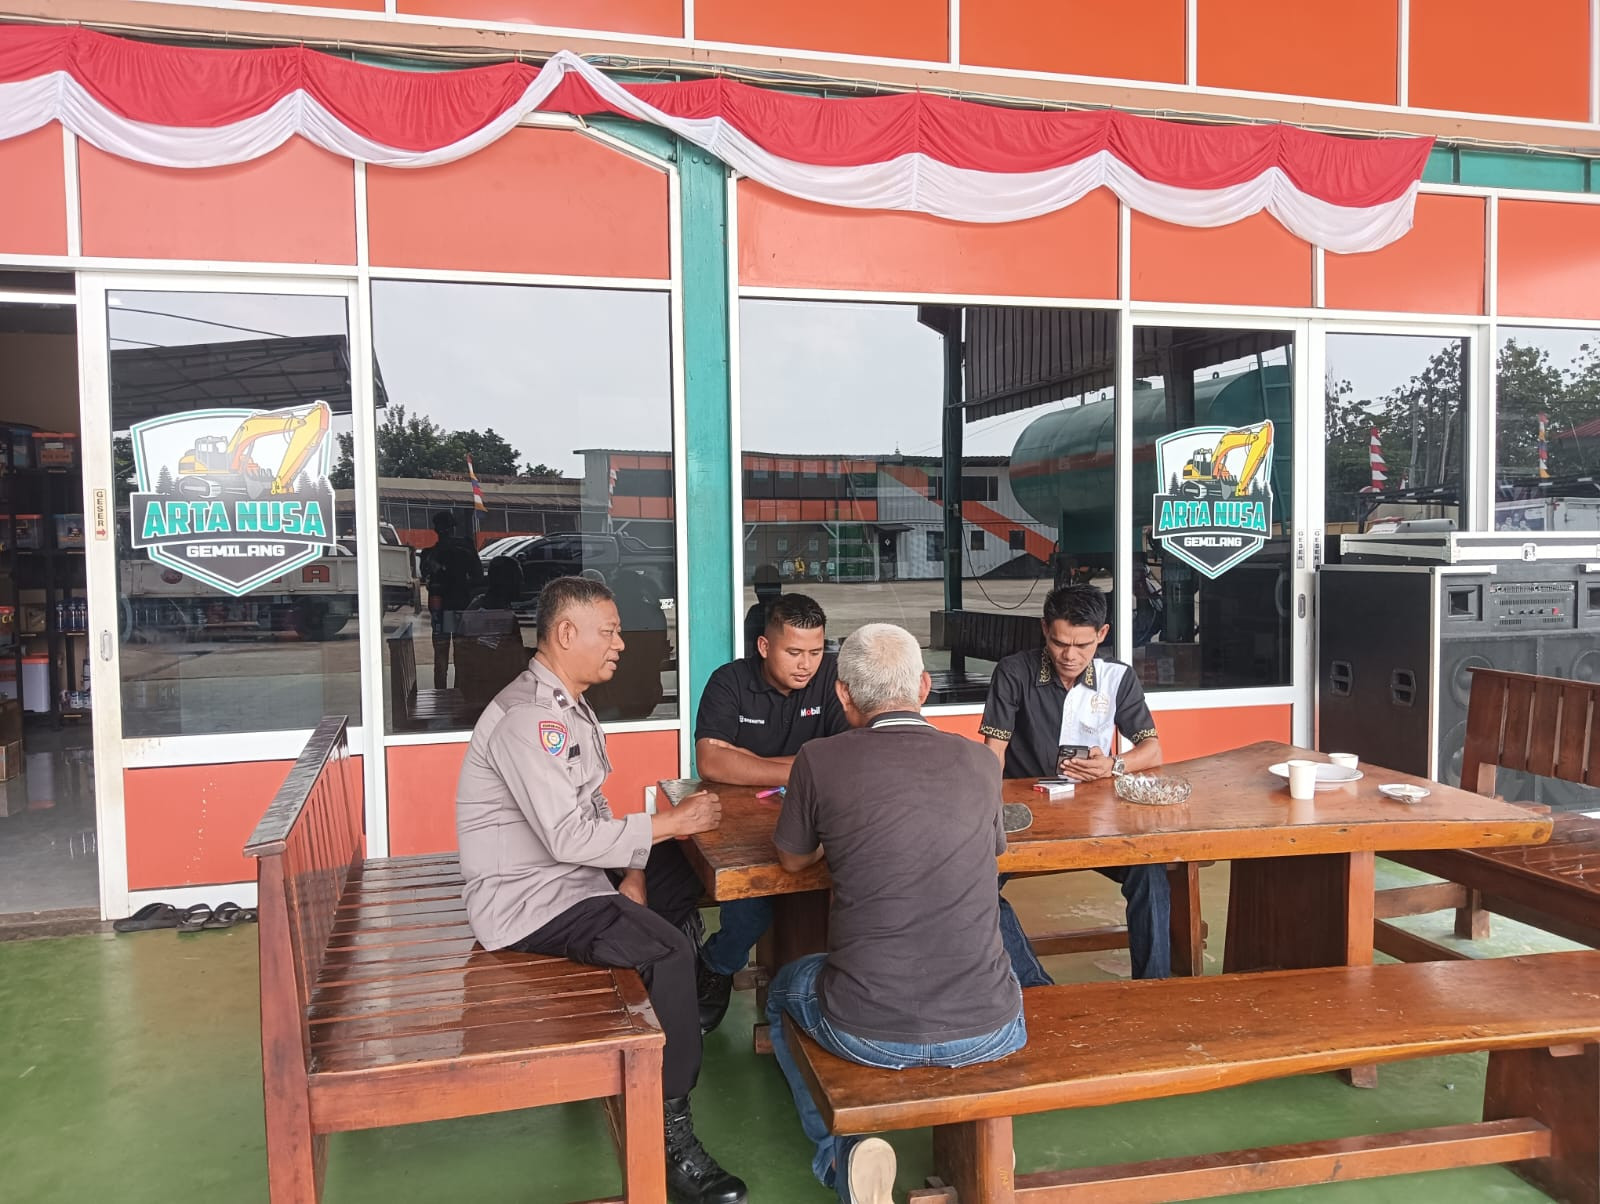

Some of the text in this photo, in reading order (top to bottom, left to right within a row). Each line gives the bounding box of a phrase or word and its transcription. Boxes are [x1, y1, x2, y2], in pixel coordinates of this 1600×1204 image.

[97, 491, 105, 527] GESER
[141, 501, 326, 539] ARTA NUSA
[1158, 501, 1267, 532] ARTA NUSA
[186, 544, 285, 558] GEMILANG
[1183, 536, 1242, 547] GEMILANG
[800, 706, 821, 717] Mobil
